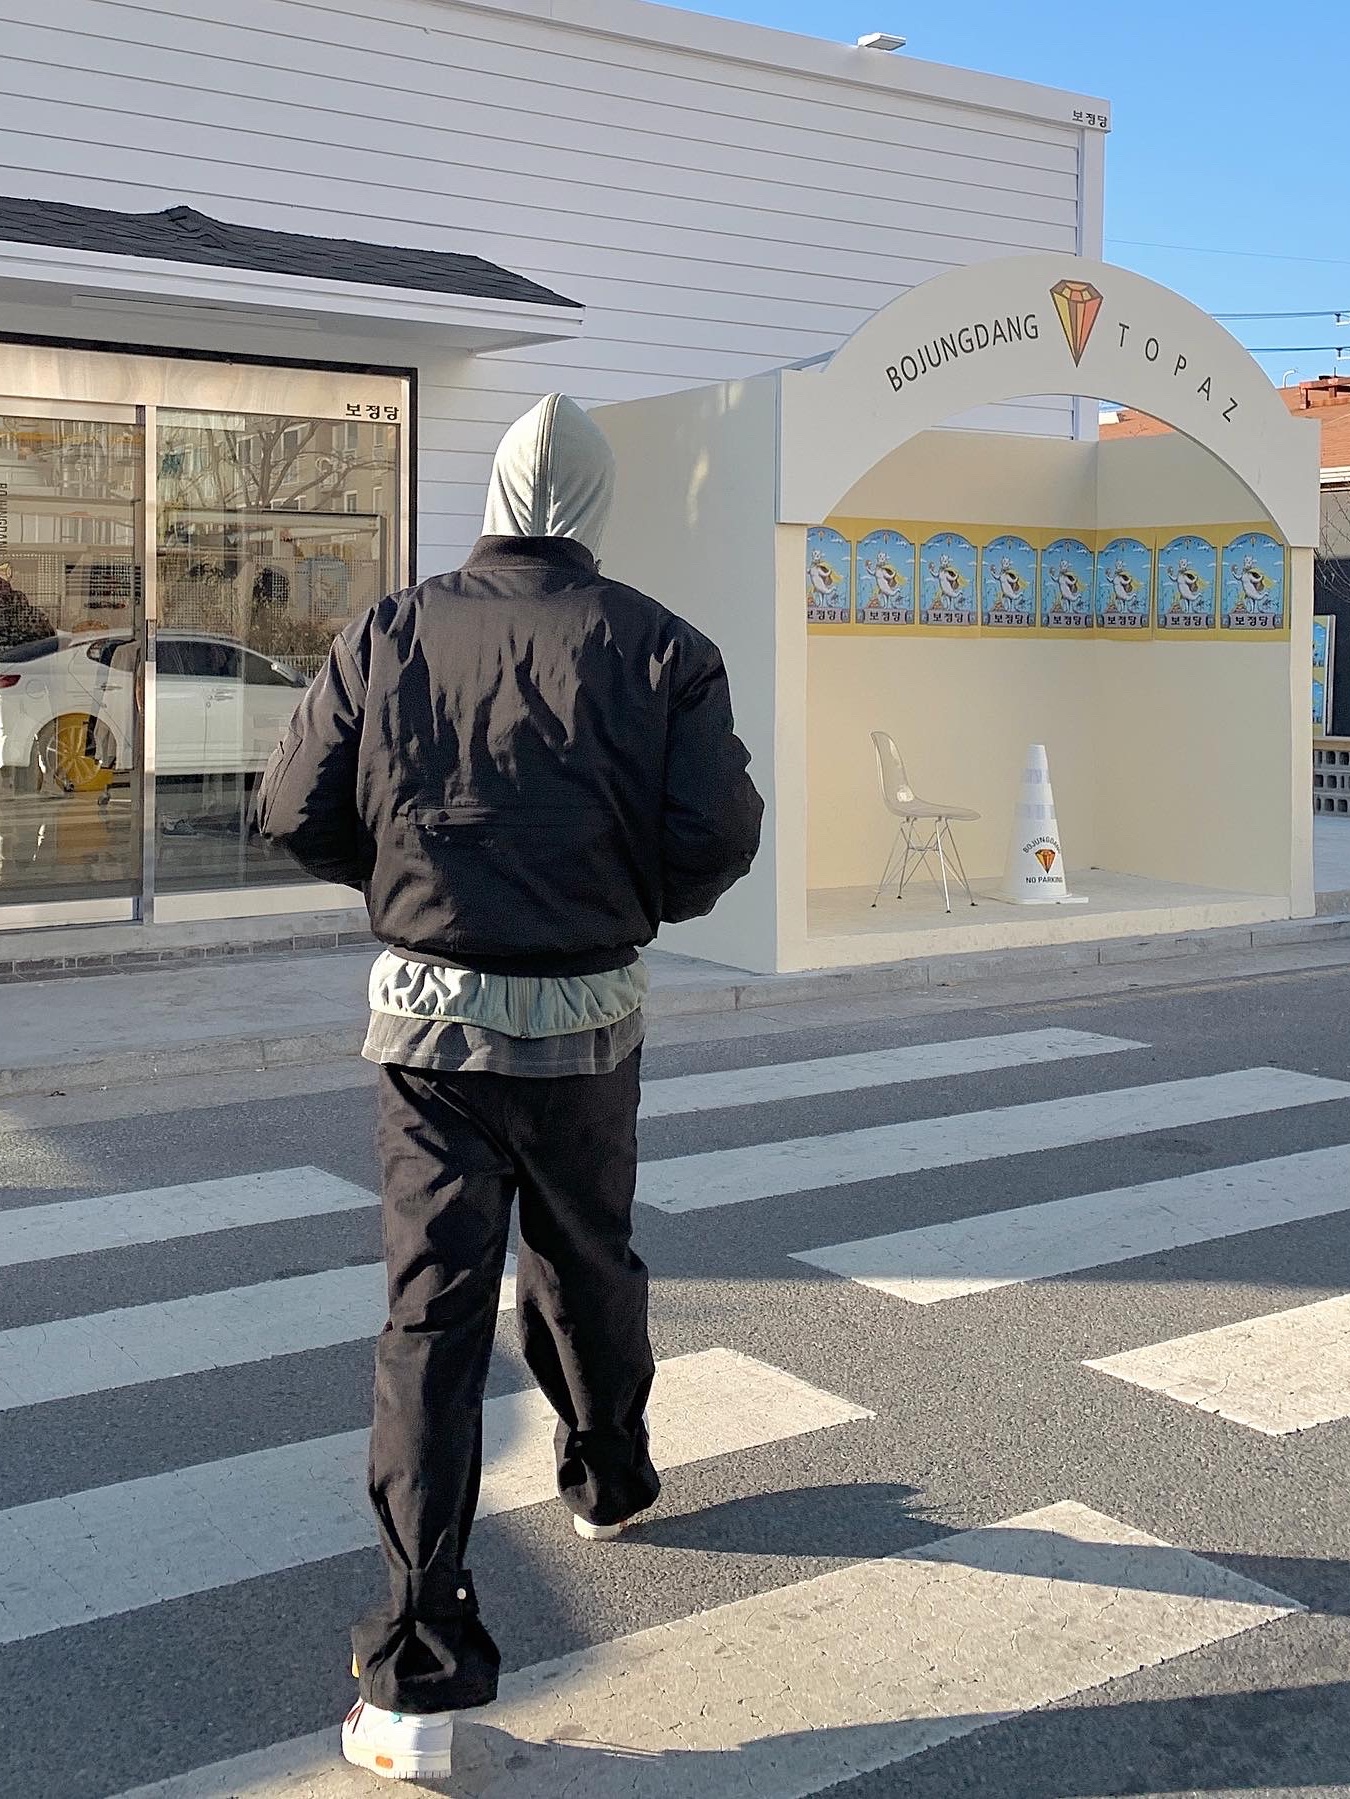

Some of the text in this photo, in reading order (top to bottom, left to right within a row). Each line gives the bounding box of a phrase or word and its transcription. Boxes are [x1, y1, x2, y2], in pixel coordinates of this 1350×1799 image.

[1072, 110, 1107, 128] 보정당
[885, 314, 1239, 423] BOJUNGDANG TOPAZ
[345, 403, 399, 420] 보정당
[869, 611, 900, 622] 보정당
[933, 613, 963, 623] 보정당
[994, 614, 1023, 624] 보정당
[1053, 615, 1081, 625] 보정당
[1107, 616, 1136, 626] 보정당
[1171, 616, 1202, 626] 보정당
[1235, 616, 1267, 626] 보정당
[1025, 876, 1036, 884] NO
